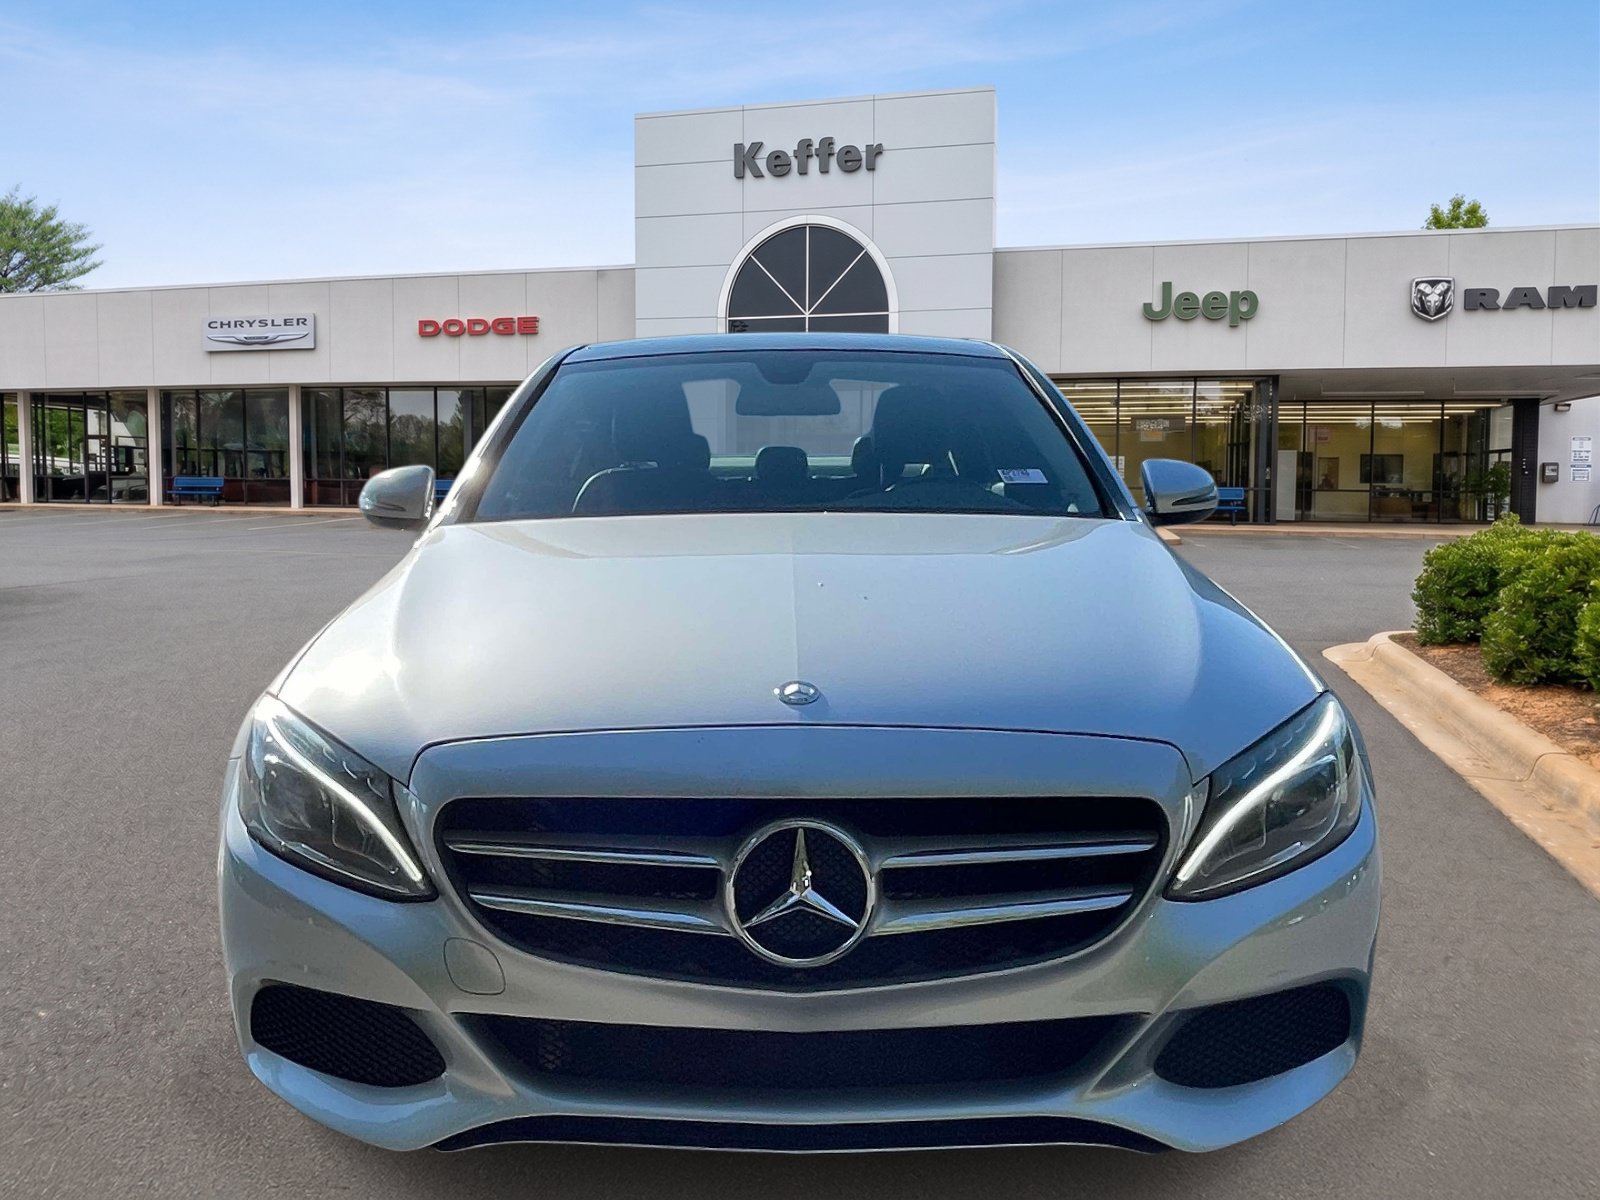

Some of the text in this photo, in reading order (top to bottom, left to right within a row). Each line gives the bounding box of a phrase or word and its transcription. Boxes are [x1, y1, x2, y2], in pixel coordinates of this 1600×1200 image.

[733, 137, 883, 178] Keffer
[1142, 281, 1259, 327] Jeep
[1464, 285, 1598, 310] RAM
[207, 317, 308, 329] CHRYSLER
[418, 316, 539, 337] DODGE
